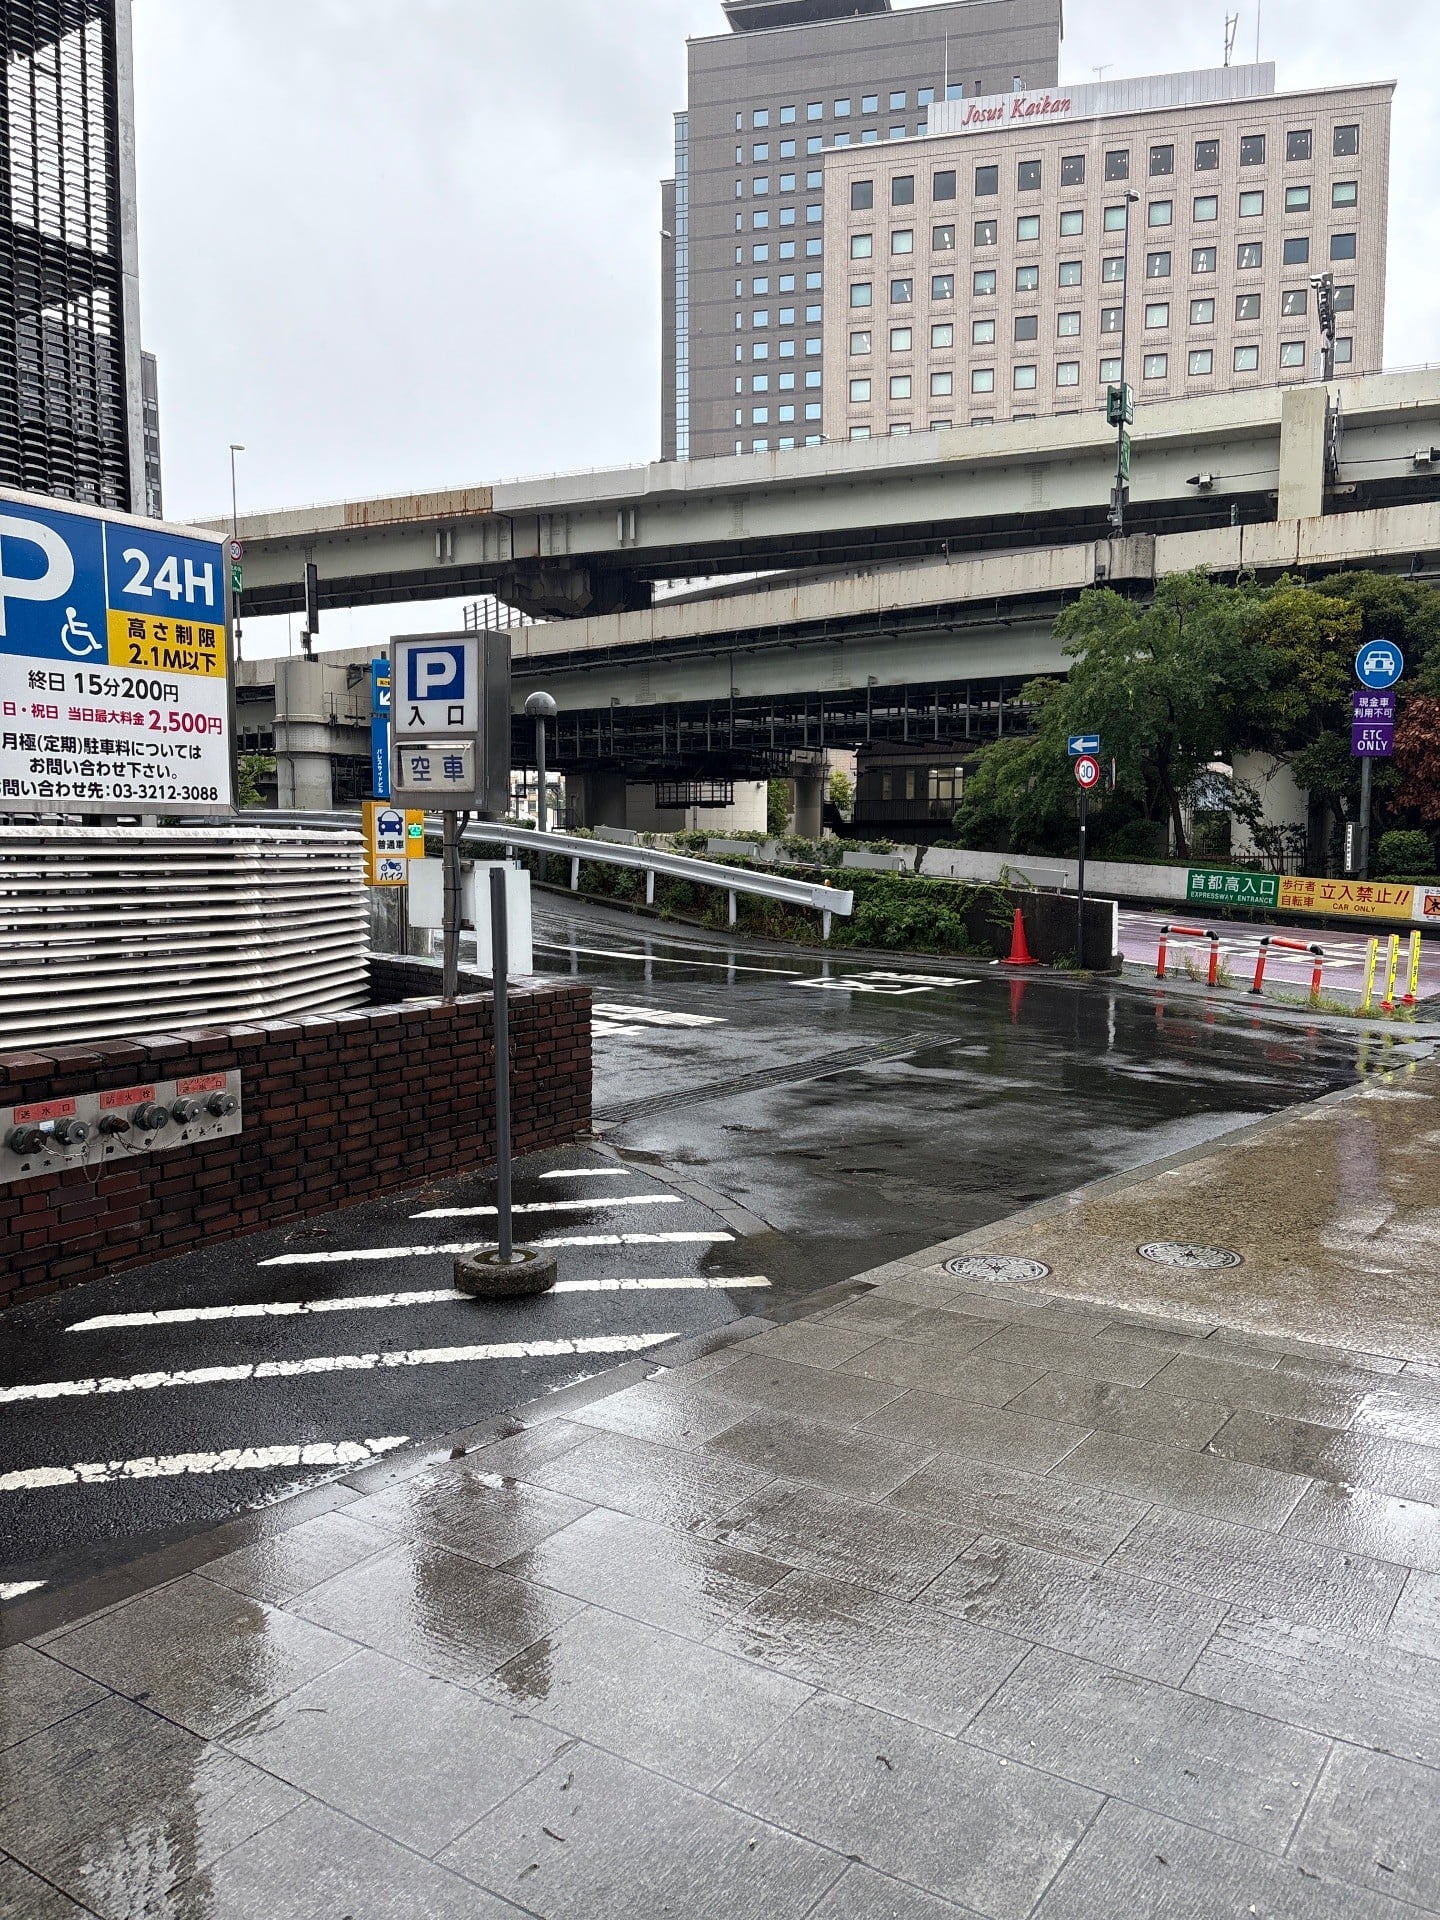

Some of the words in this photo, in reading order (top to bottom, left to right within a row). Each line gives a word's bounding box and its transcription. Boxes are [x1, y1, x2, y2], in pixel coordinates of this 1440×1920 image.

[962, 101, 1005, 126] Josui
[1010, 95, 1071, 118] Kaikan
[122, 548, 213, 606] 24H
[127, 617, 216, 648] 高さ制限
[128, 643, 217, 673] 2.1M以下
[416, 651, 457, 698] P
[28, 670, 65, 692] 終日
[74, 672, 179, 702] 15分200円
[1354, 708, 1393, 718] 利用不可
[1359, 697, 1389, 708] 現金車
[68, 706, 145, 726] 当日最大料金
[148, 709, 222, 735] 2,500円
[408, 705, 464, 727] 入口
[2, 732, 202, 760] 月極(定期)駐車料については
[1357, 740, 1388, 751] ONLY
[1363, 730, 1382, 740] ETC
[29, 757, 178, 780] お問い合わせ下さい。
[411, 754, 465, 783] 空車
[1081, 764, 1093, 779] 30
[0, 779, 218, 801] 問い合わせ先:03-3212-3088
[377, 839, 404, 850] 普通車
[380, 872, 403, 881] バイク
[1191, 873, 1275, 896] 首都高入口
[1282, 880, 1316, 893] 歩行者
[1191, 892, 1234, 901] EXPRESSWAY
[1237, 895, 1273, 904] ENTRANCE
[1281, 895, 1314, 907] 自転車
[1333, 903, 1350, 911] CAR
[1354, 905, 1376, 913] ONLY
[20, 1103, 70, 1120] 送水口
